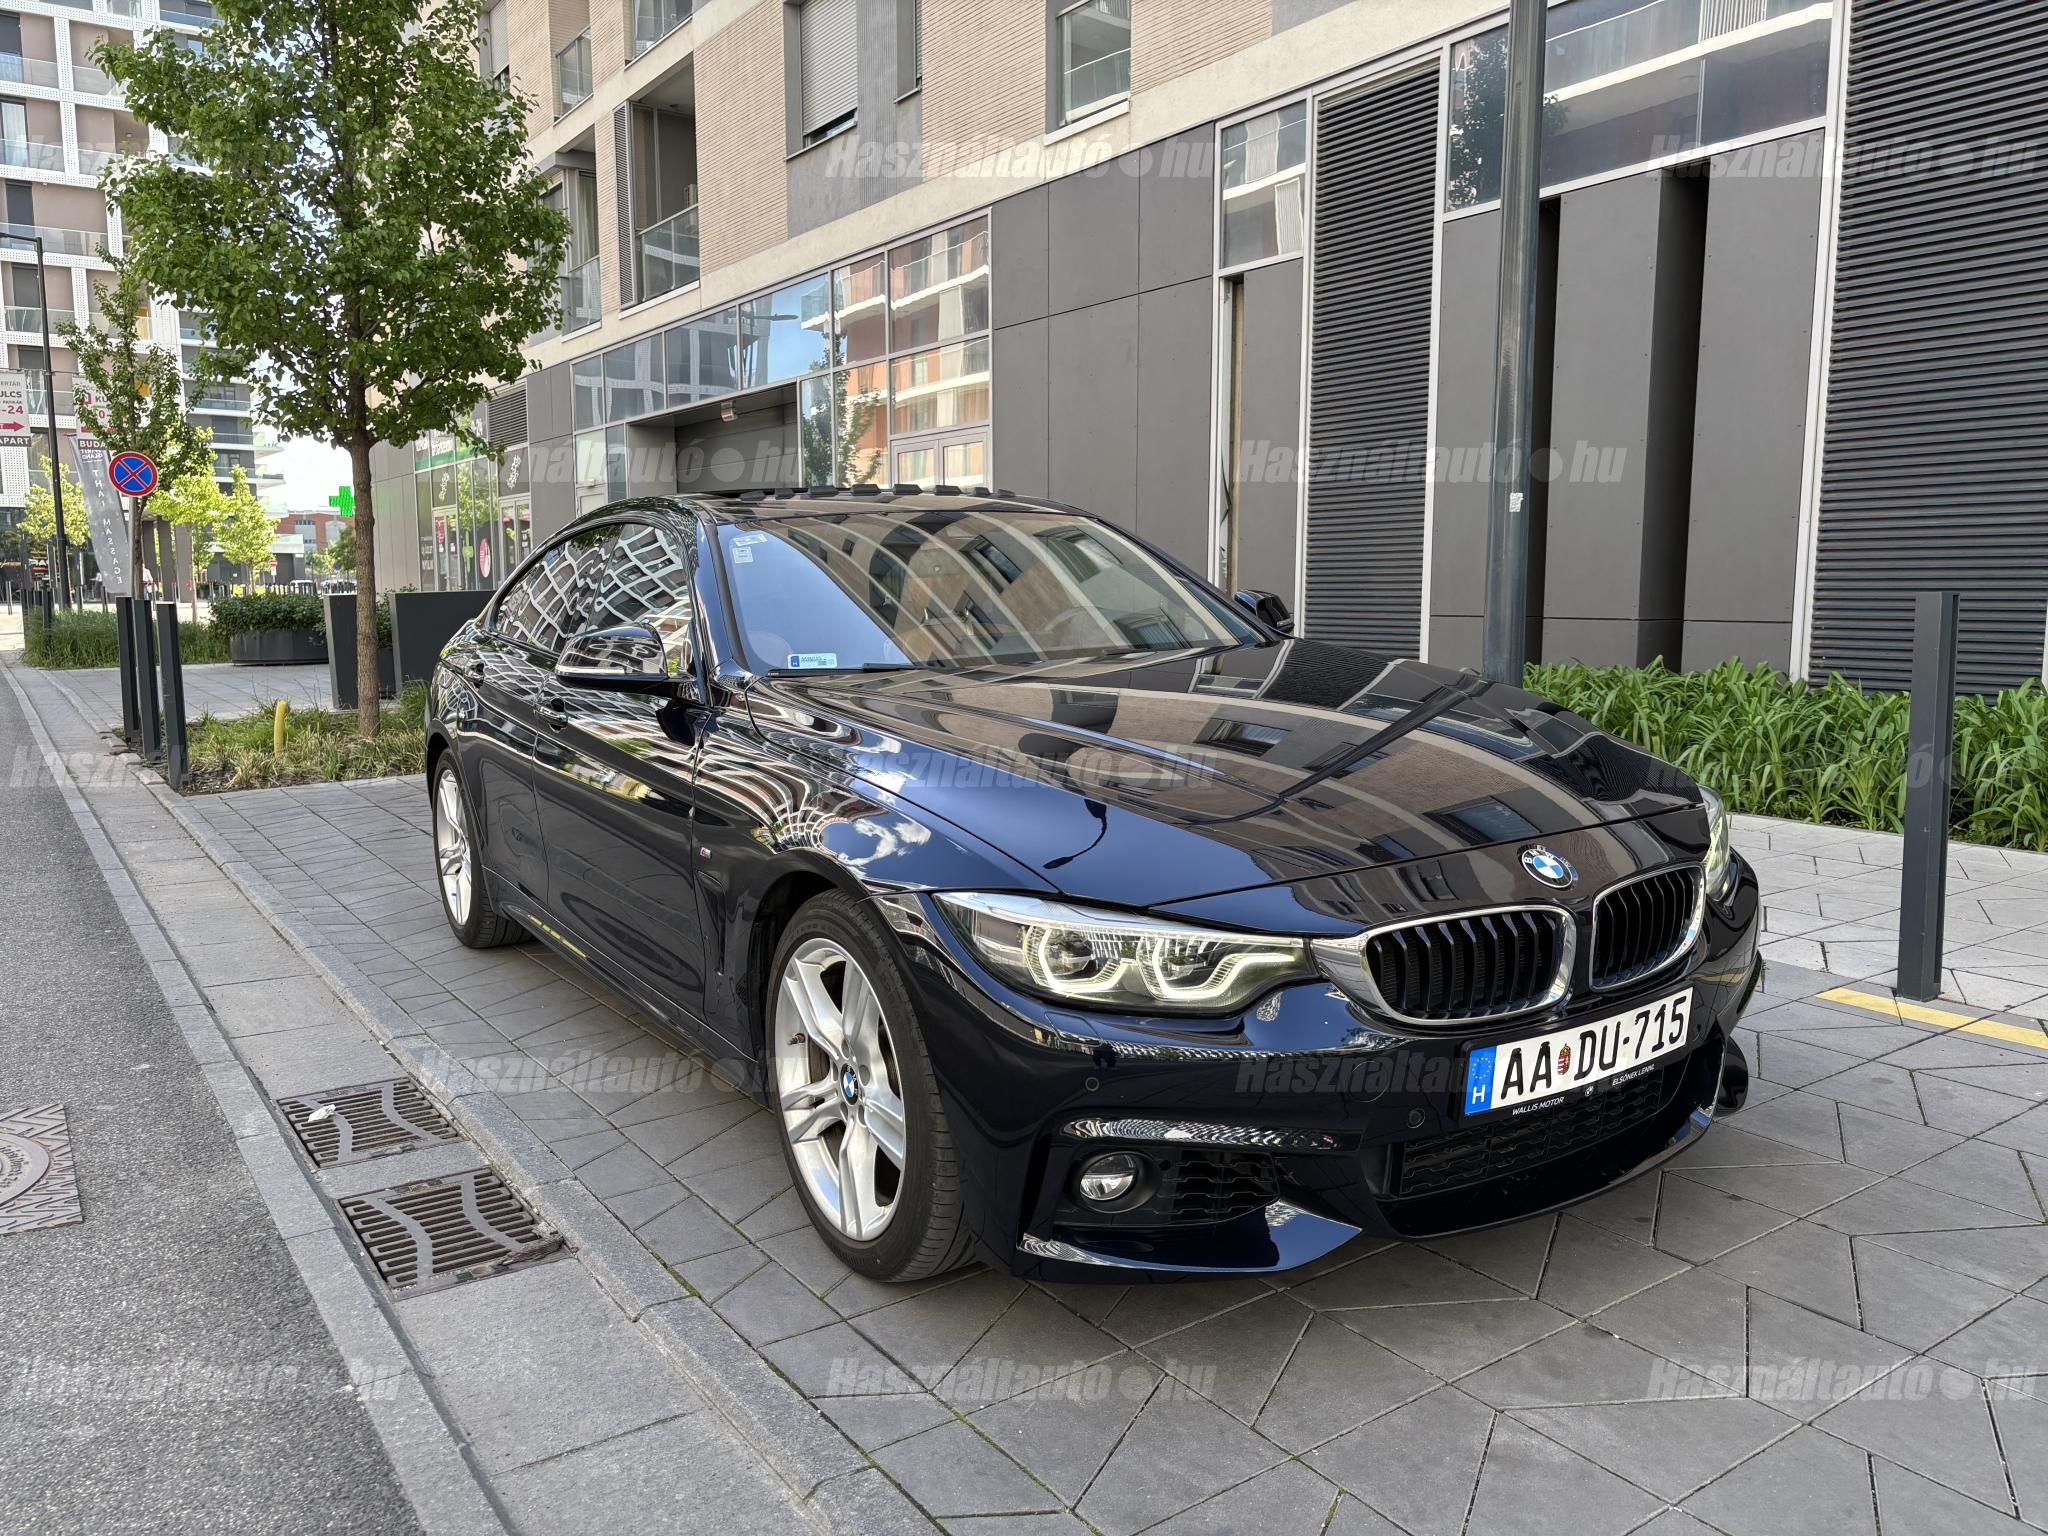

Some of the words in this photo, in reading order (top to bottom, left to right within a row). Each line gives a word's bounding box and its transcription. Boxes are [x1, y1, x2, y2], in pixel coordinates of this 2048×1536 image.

[79, 440, 106, 448] BUDA
[1501, 1041, 1552, 1100] AA
[1574, 995, 1688, 1082] DU-715
[1471, 1085, 1487, 1104] H
[1512, 1103, 1538, 1116] WALLIS
[1539, 1096, 1565, 1109] MOTOR
